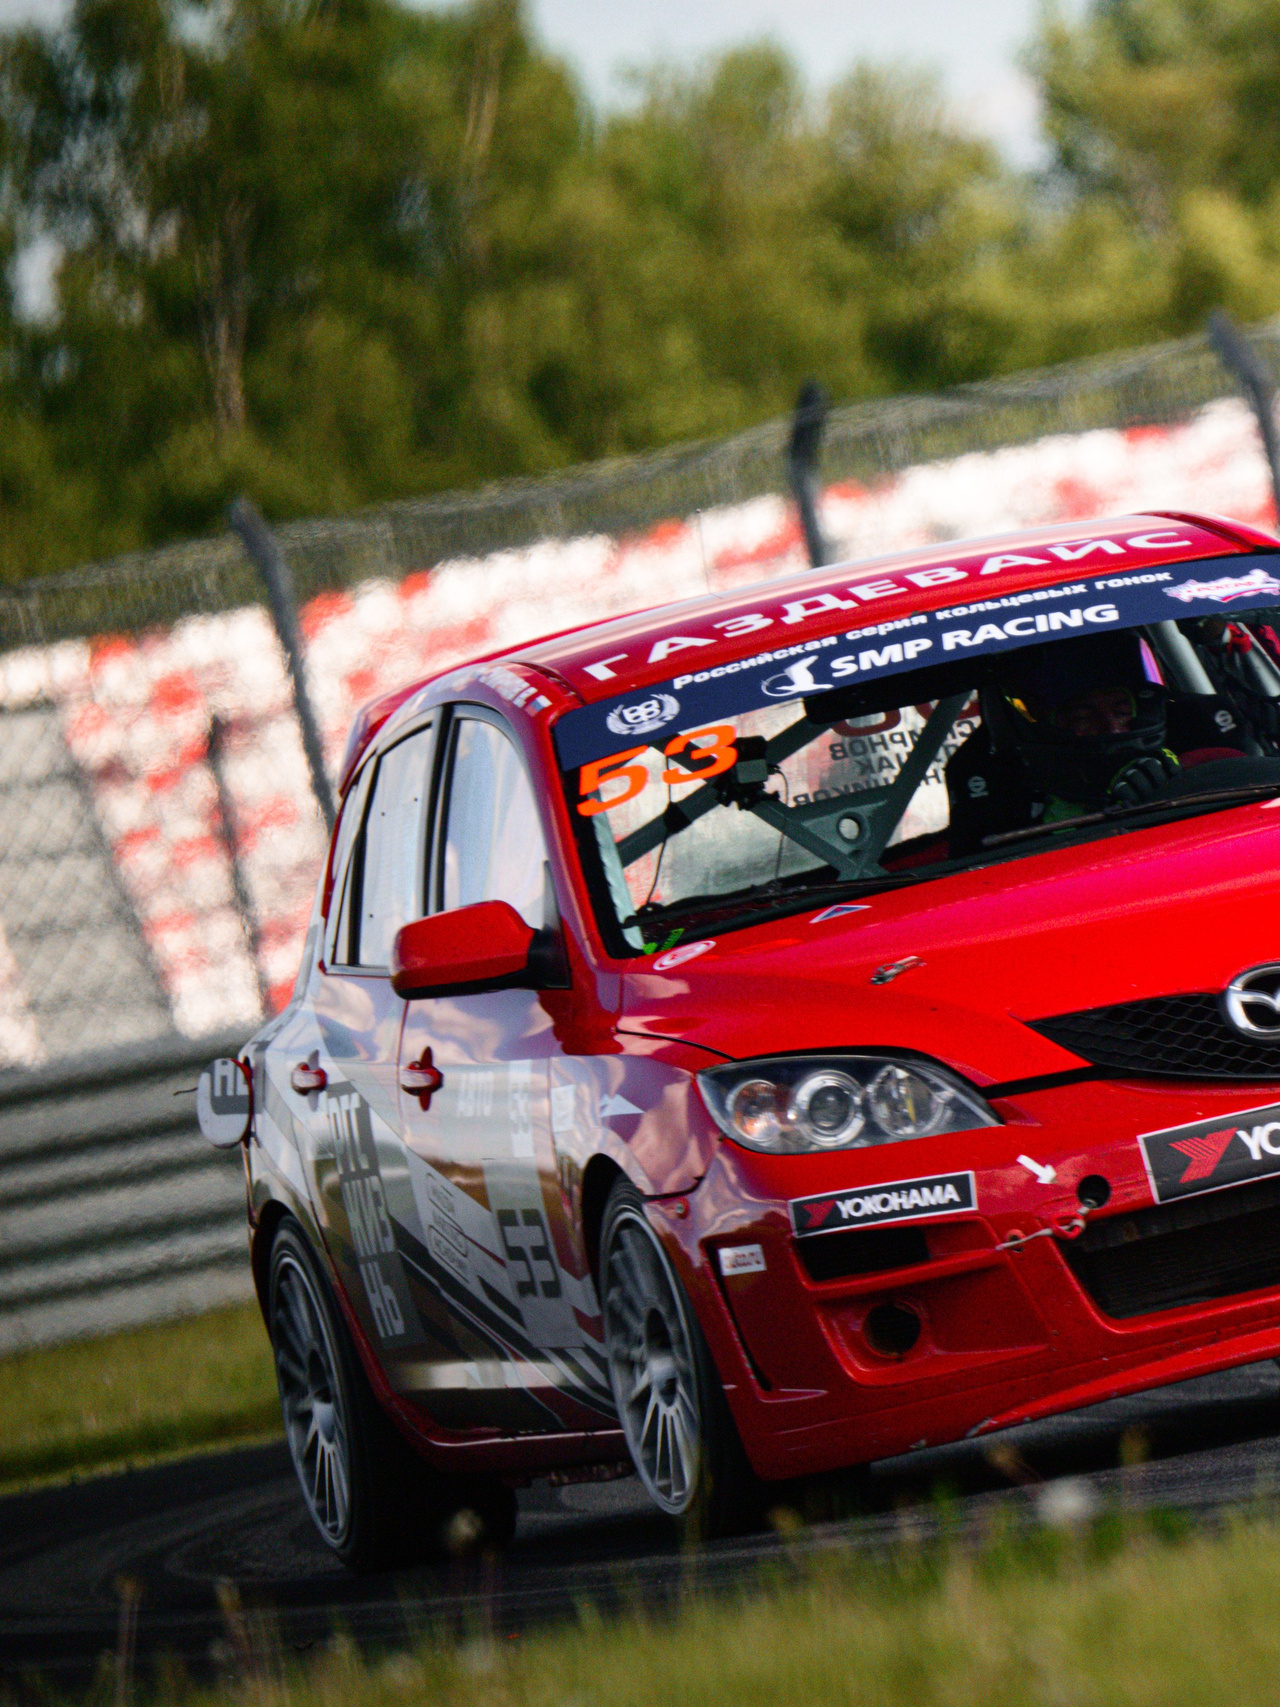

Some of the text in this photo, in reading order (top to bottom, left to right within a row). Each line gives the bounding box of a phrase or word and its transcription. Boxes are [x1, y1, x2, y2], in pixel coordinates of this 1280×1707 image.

[582, 531, 1193, 682] ГАЗДЕВАЙС
[672, 636, 838, 690] Российская
[845, 614, 928, 642] серия
[935, 581, 1089, 620] кольцевых
[1094, 571, 1174, 590] гонок
[829, 603, 1120, 678] SMP RACING
[576, 724, 738, 817] 53
[836, 1183, 962, 1219] YOKOHAMA
